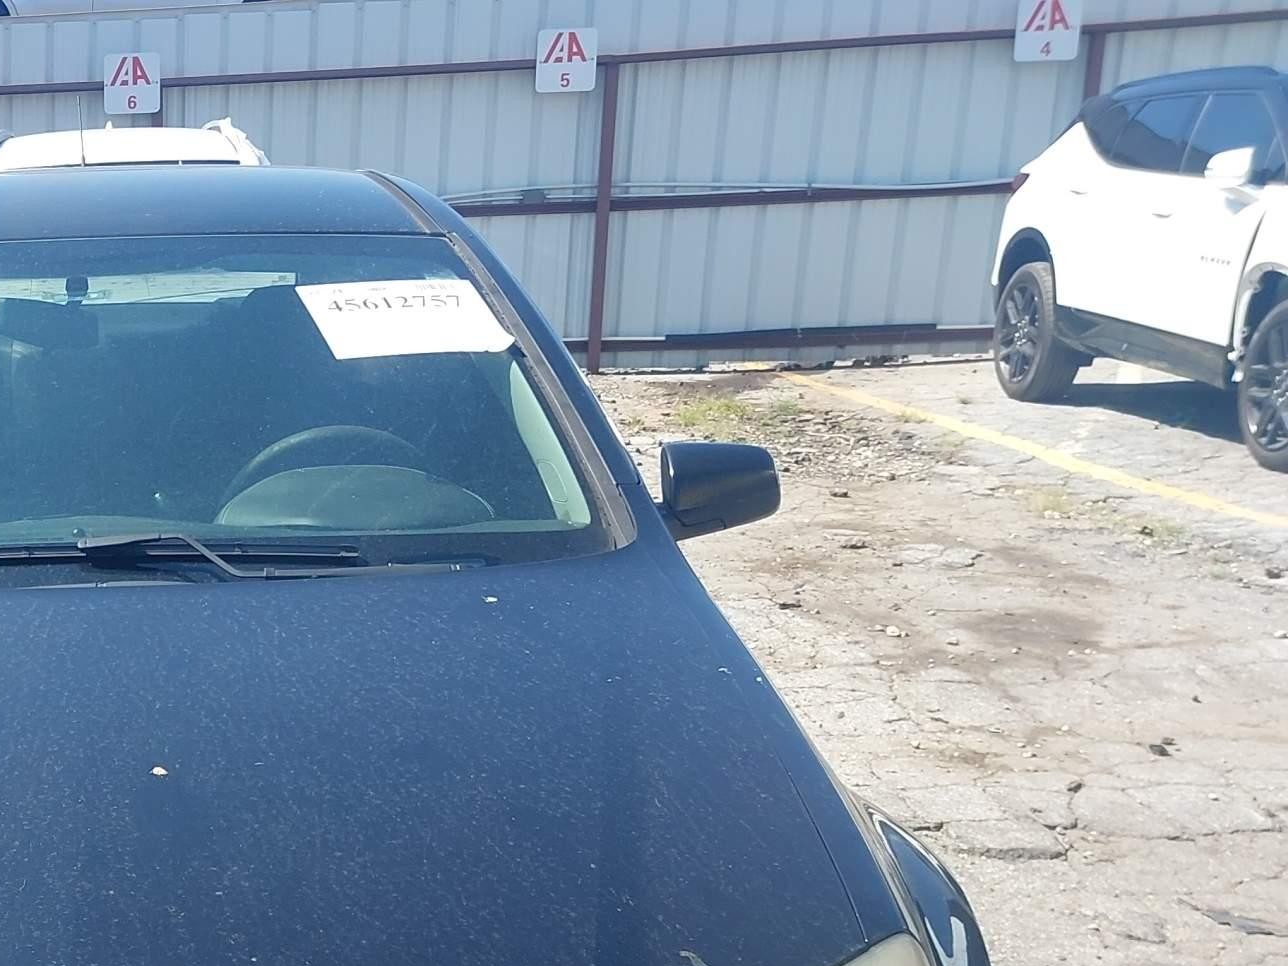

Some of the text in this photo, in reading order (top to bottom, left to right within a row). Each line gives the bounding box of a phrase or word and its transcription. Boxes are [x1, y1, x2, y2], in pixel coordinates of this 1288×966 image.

[1039, 40, 1052, 57] 4
[559, 72, 571, 88] 5
[127, 95, 138, 110] 6
[326, 294, 462, 313] 45612757
